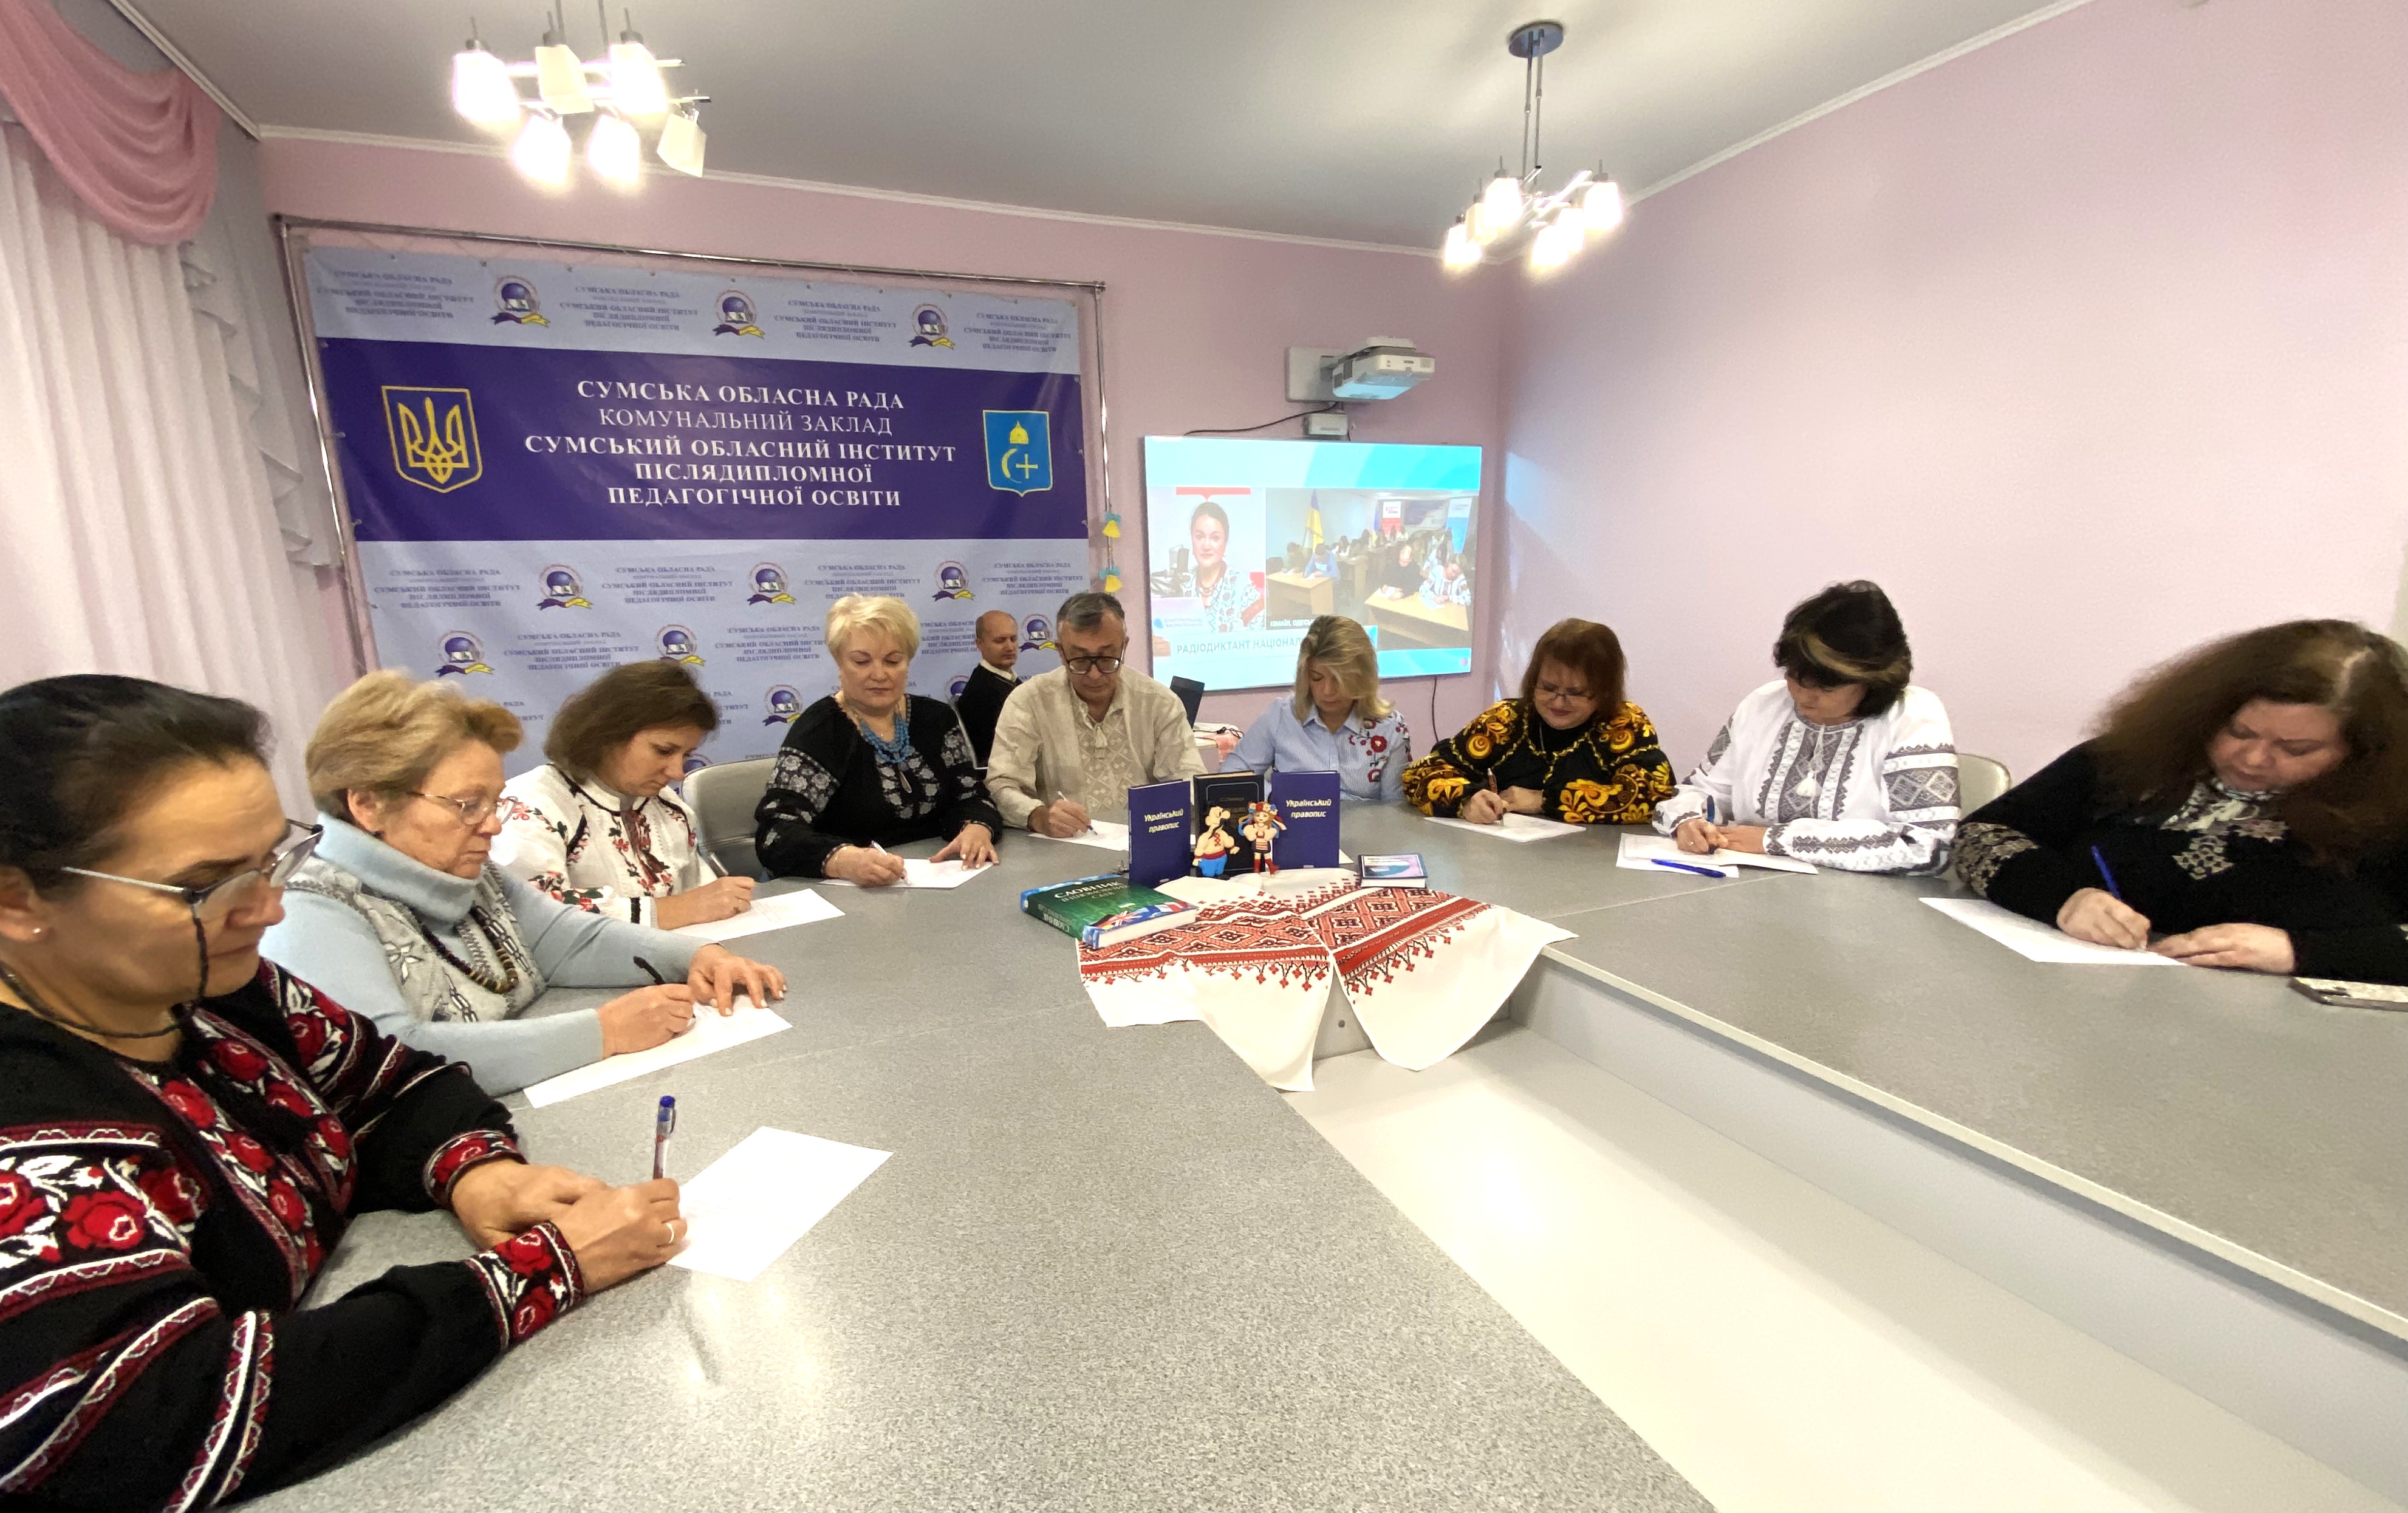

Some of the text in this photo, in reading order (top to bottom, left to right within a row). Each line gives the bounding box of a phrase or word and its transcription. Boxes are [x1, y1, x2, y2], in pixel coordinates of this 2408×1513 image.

[578, 381, 903, 411] СУМСЬКА ОБЛАСНА РАДА
[600, 409, 892, 435] КОМУНАЛЬНИЙ ЗАКЛАД
[525, 435, 955, 461] СУМСЬКИЙ ОБЛАСНИЙ ІНСТИТУТ
[635, 463, 872, 483] ПІСЛЯДИПЛОМНОЇ
[608, 487, 900, 507] ПЕДАГОГІЧНОЇ ОСВІТИ
[1177, 638, 1304, 654] РАДІОДИКТАНТ НАЦІОНАЛ
[1286, 799, 1332, 807] Український
[1144, 808, 1184, 822] Український
[1149, 822, 1180, 833] правопис
[1055, 881, 1123, 898] СЛОВНИК
